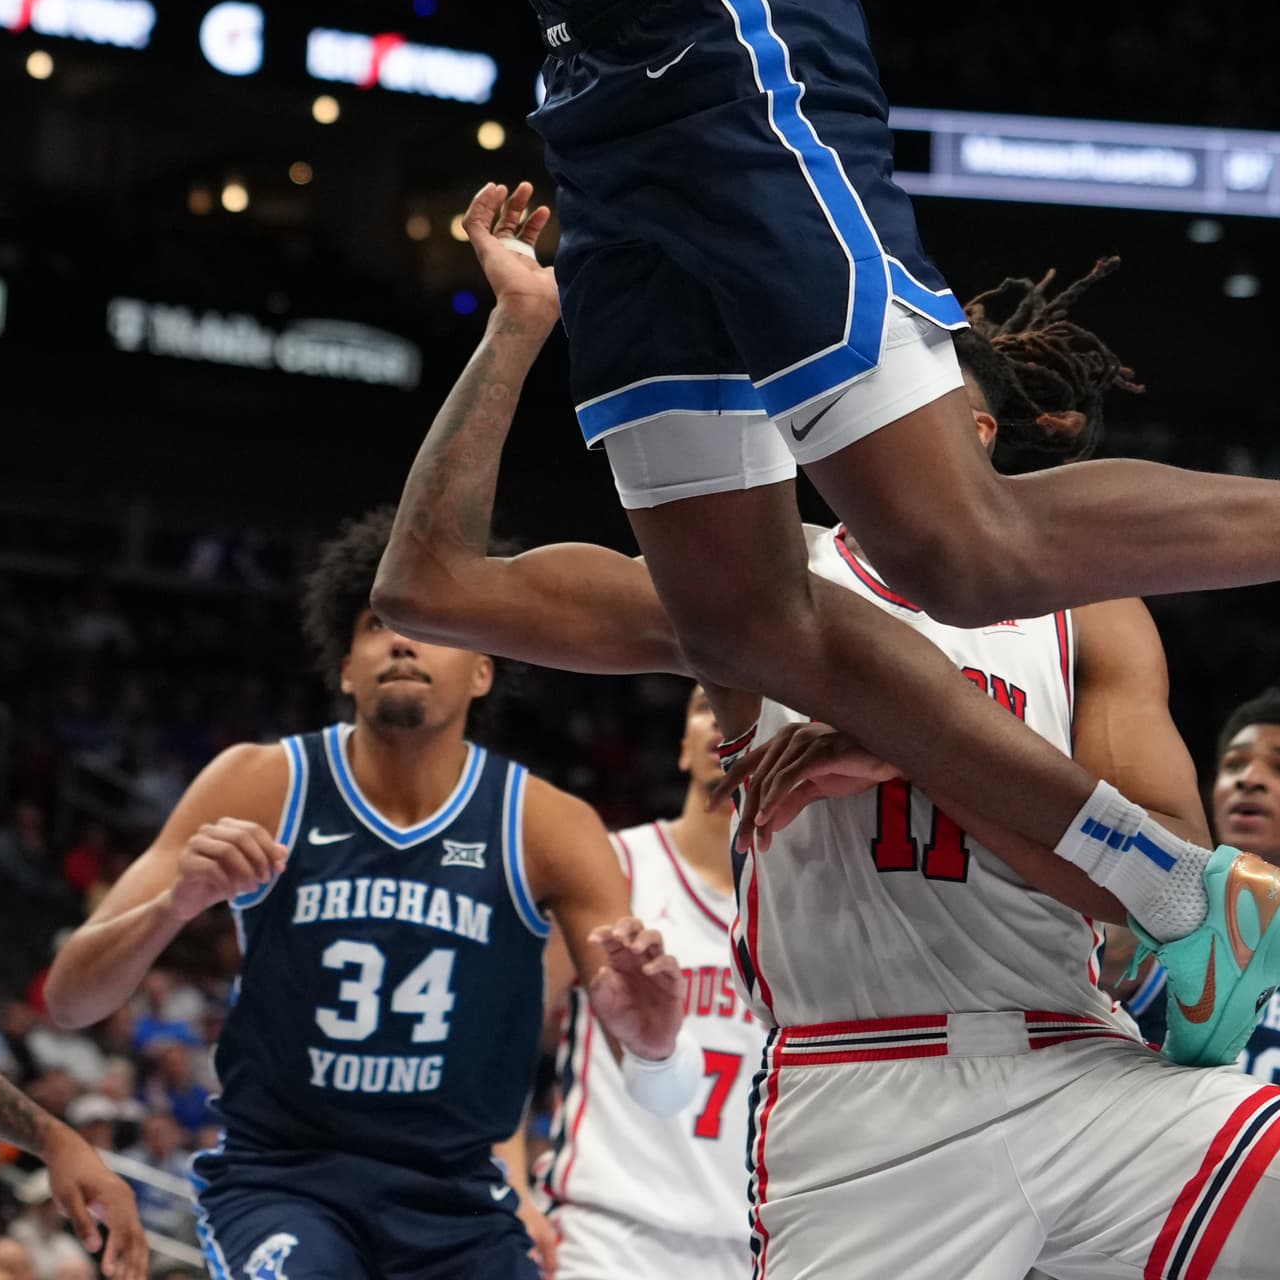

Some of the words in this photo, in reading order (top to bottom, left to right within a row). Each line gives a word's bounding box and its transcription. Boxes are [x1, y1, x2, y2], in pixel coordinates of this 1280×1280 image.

[293, 877, 493, 944] BRIGHAM
[315, 938, 457, 1043] 34
[308, 1047, 443, 1093] YOUNG
[693, 1048, 743, 1140] 7
